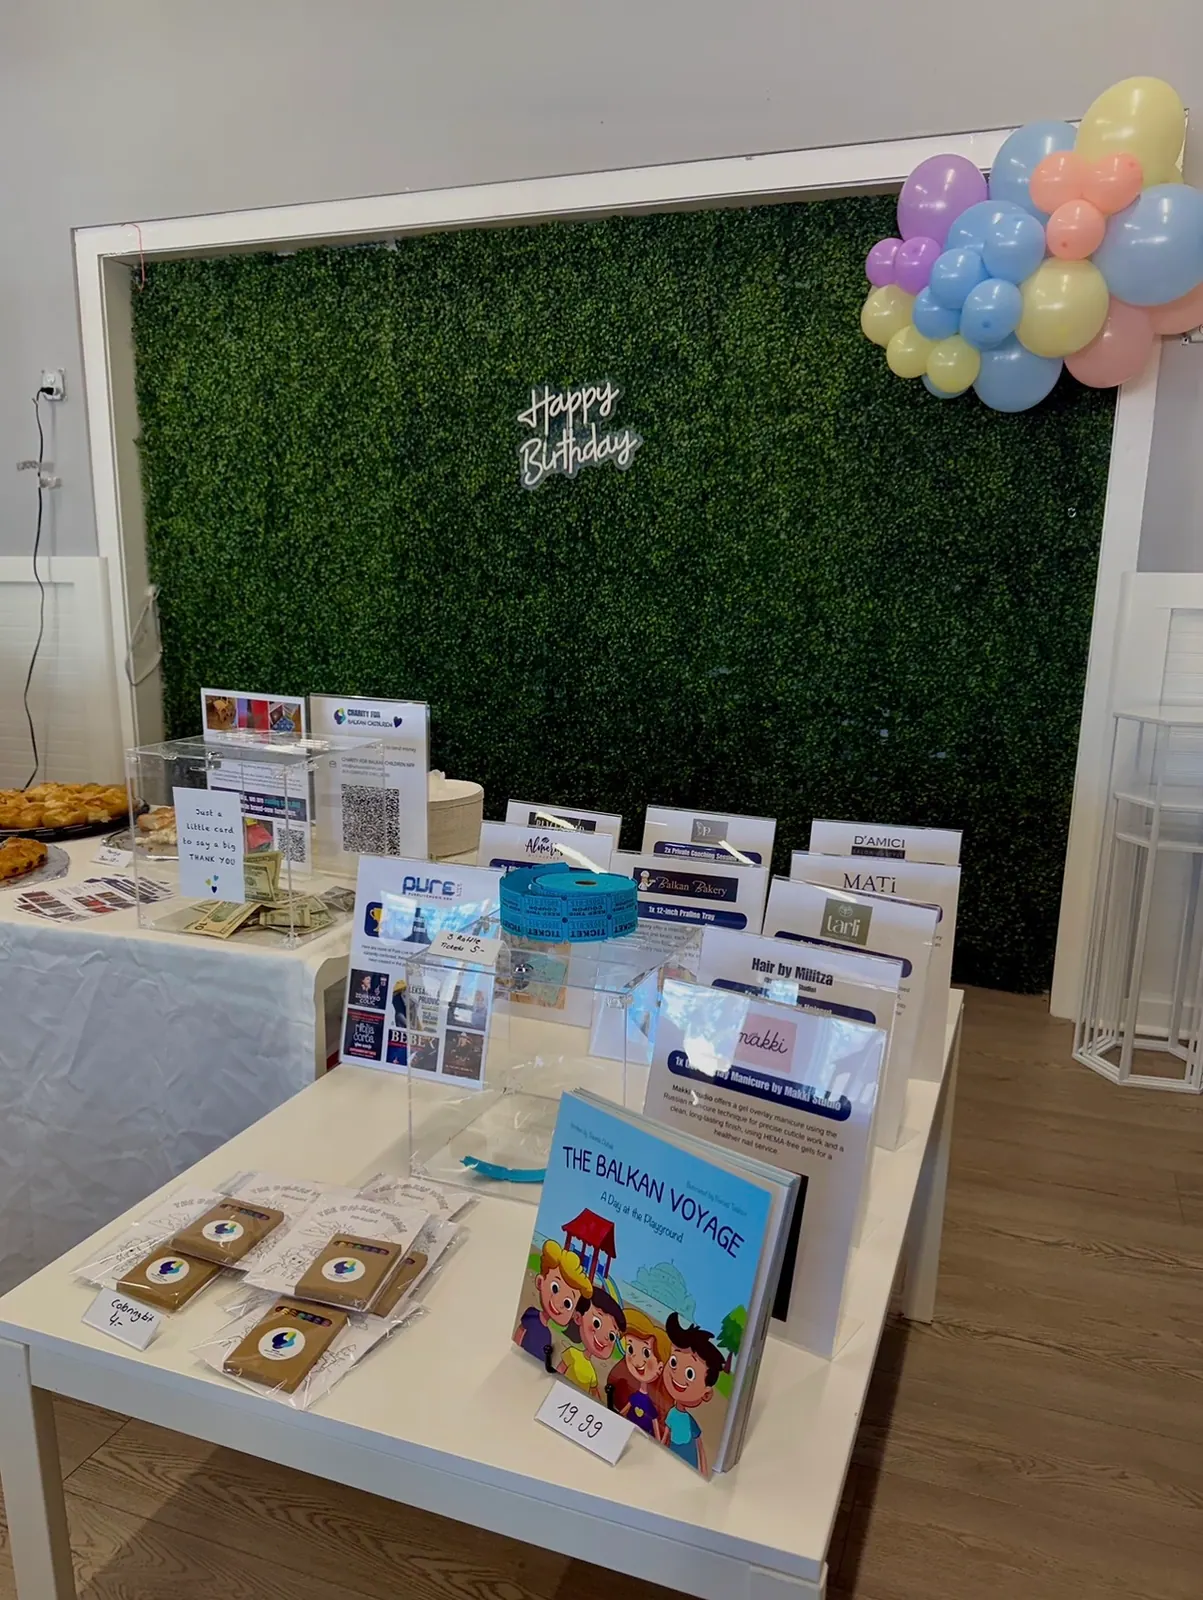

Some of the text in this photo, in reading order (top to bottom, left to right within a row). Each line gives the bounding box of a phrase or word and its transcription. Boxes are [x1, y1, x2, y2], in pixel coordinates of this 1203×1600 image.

[517, 382, 620, 436] Happy
[520, 422, 638, 485] Birthday
[196, 808, 213, 817] Just
[186, 823, 210, 832] little
[854, 835, 905, 848] D'AMICI
[183, 837, 192, 845] to
[196, 840, 210, 850] say
[222, 841, 236, 852] big
[189, 853, 236, 866] THANK YOU
[656, 876, 727, 898] Balkan Bakery
[656, 906, 678, 916] 12-inch
[702, 912, 716, 922] Tray
[570, 928, 606, 938] TICKET
[752, 957, 834, 986] Hair by Militza
[730, 1071, 770, 1091] Manicure
[771, 1083, 784, 1095] by
[784, 1085, 810, 1102] Makki
[672, 1084, 691, 1095] Makki
[749, 1106, 774, 1121] overlay
[774, 1114, 805, 1129] manicure
[806, 1123, 825, 1136] using
[826, 1130, 838, 1138] the
[758, 1120, 783, 1133] precise
[806, 1136, 823, 1146] work
[824, 1141, 839, 1151] and
[562, 1146, 593, 1173] THE
[596, 1154, 665, 1204] BALKAN
[670, 1188, 745, 1259] VOYAGE
[600, 1191, 685, 1244] A Day at the Playground
[557, 1402, 603, 1438] 19.99
